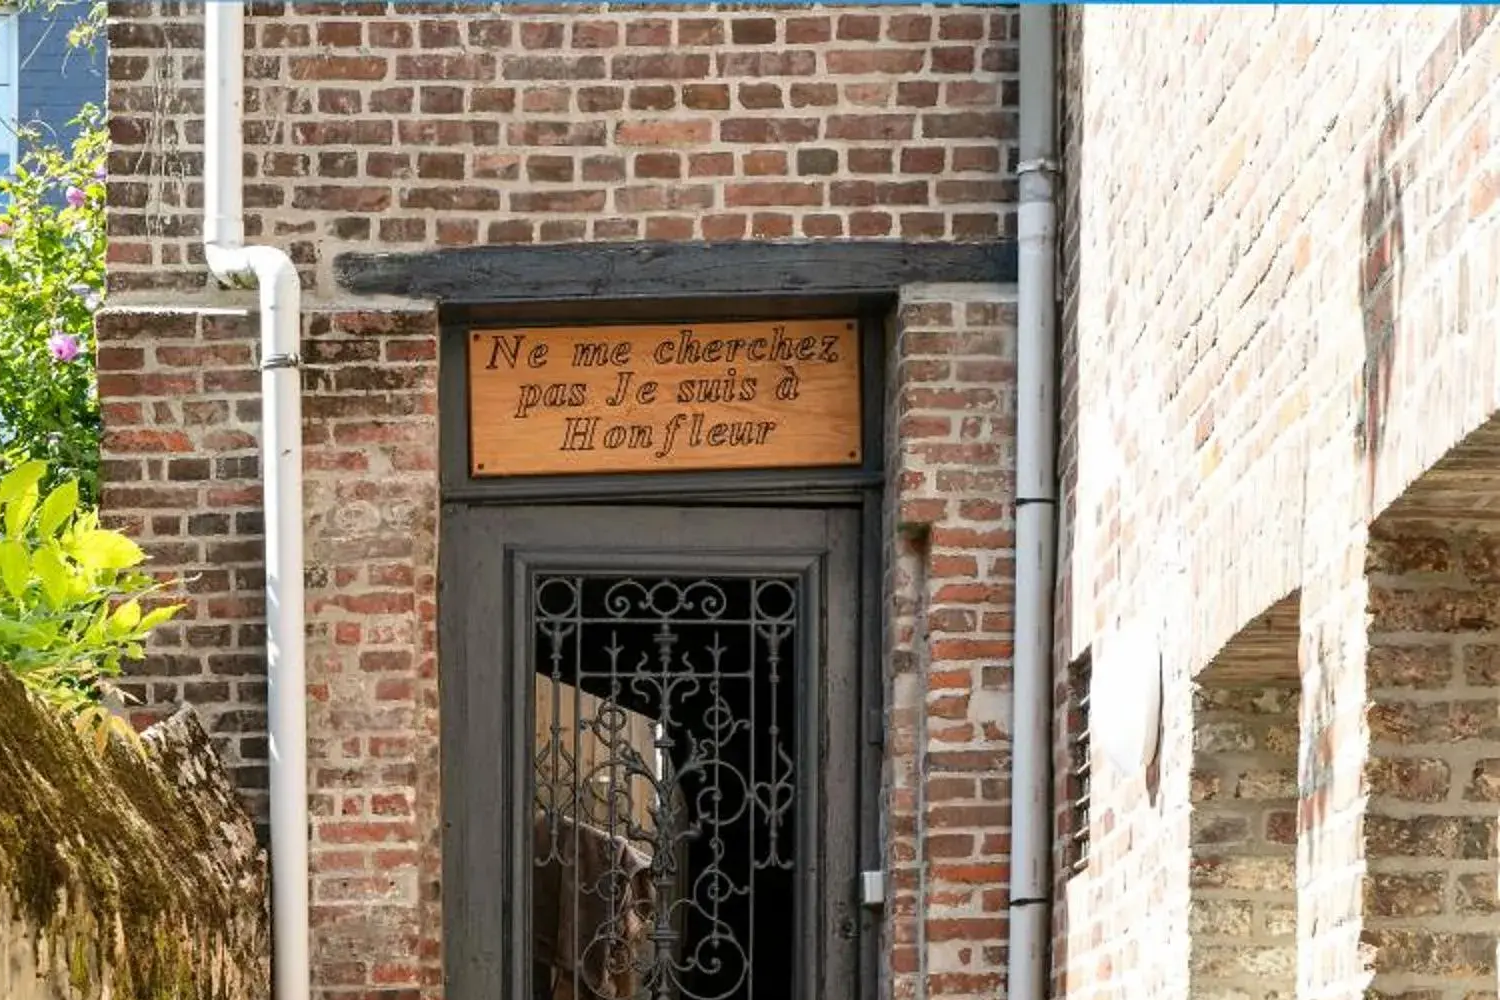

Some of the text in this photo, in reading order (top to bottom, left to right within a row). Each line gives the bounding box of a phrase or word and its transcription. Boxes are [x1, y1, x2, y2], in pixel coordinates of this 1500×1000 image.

[486, 328, 841, 369] Ne me cherchez
[514, 366, 801, 419] pas Je suis à
